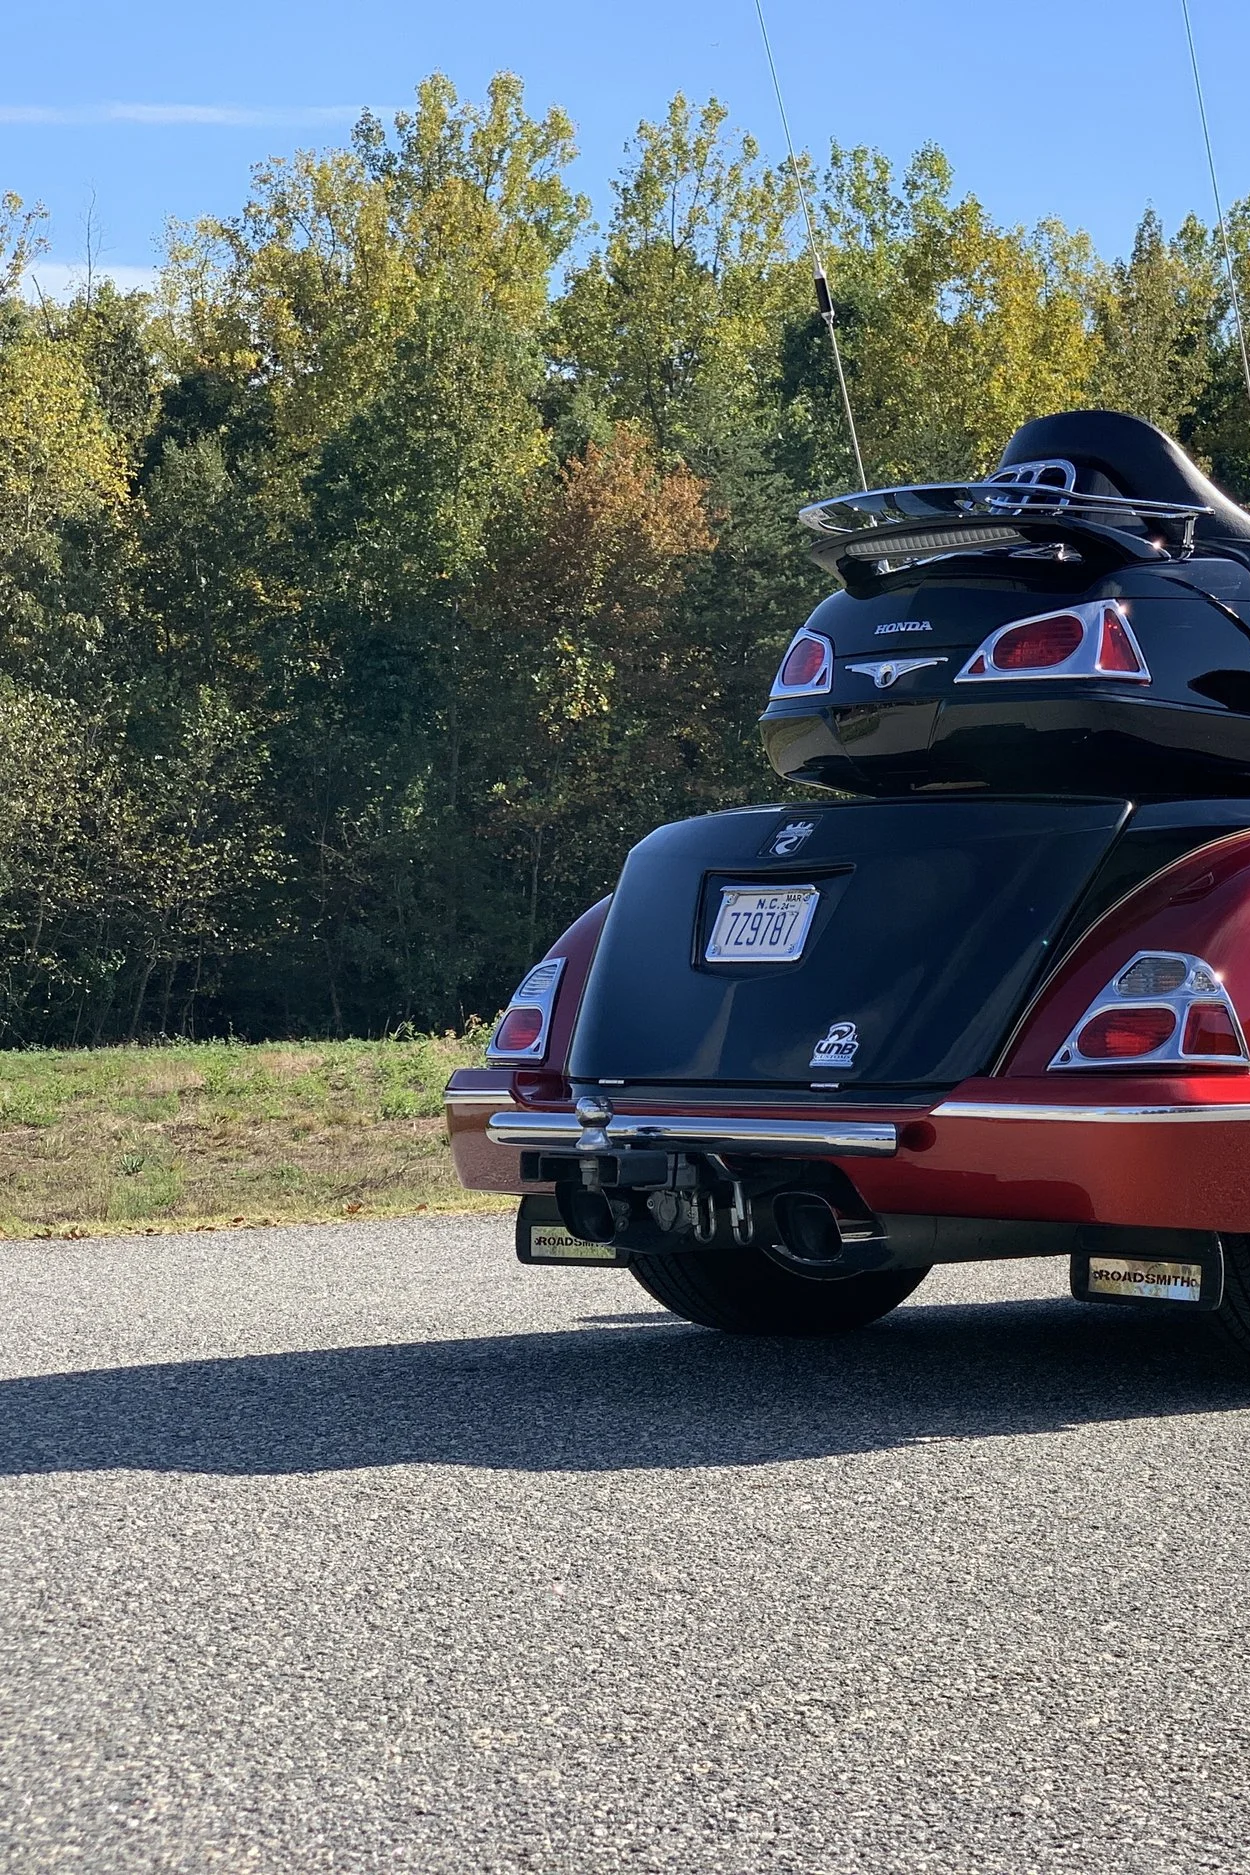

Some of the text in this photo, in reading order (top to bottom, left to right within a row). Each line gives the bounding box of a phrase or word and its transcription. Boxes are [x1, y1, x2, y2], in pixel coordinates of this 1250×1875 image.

[874, 621, 933, 635] HONDA
[786, 894, 802, 902] MAR
[724, 912, 800, 946] 729787
[1099, 1269, 1192, 1288] ROADSMITH
